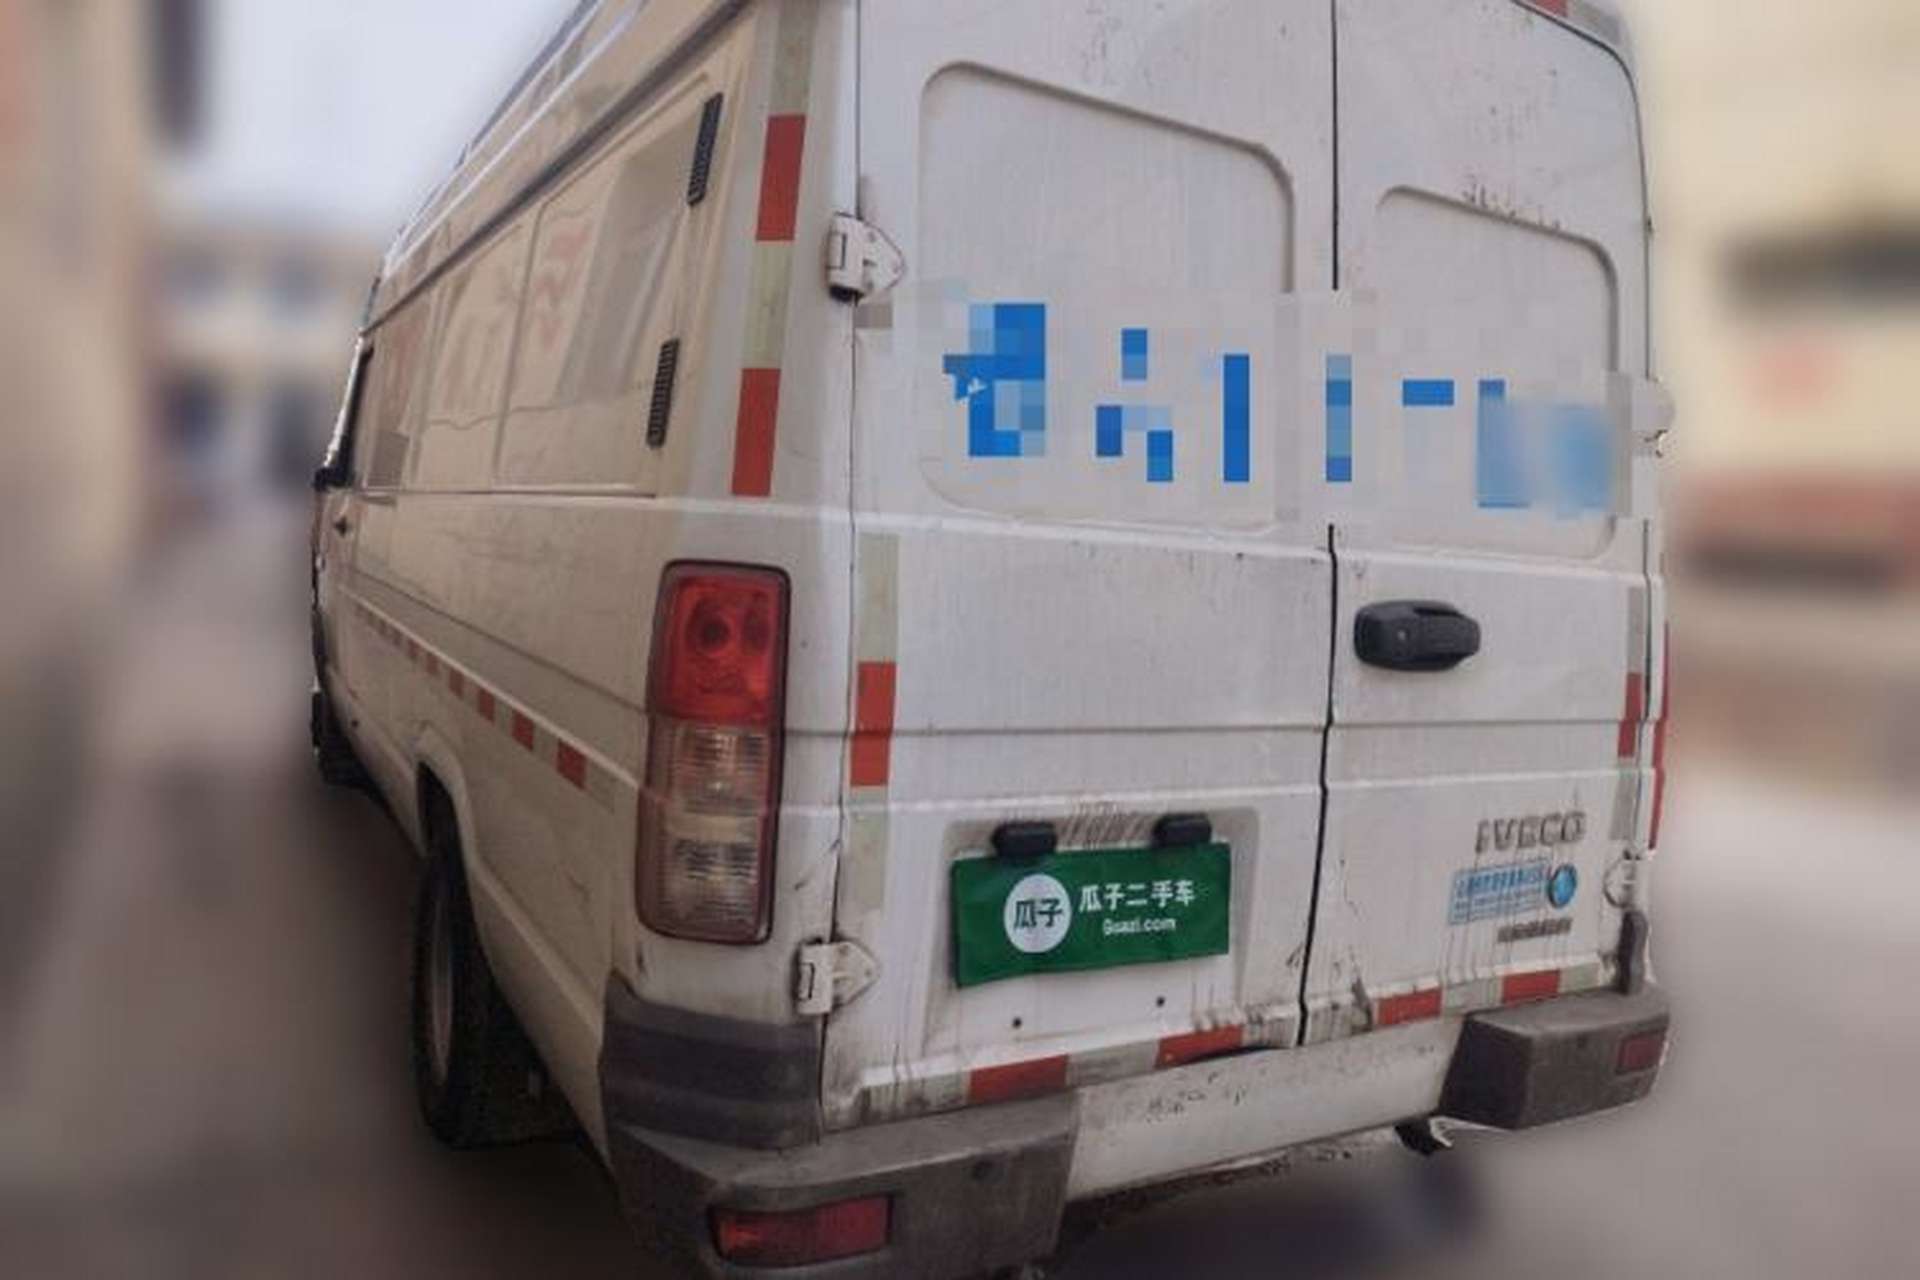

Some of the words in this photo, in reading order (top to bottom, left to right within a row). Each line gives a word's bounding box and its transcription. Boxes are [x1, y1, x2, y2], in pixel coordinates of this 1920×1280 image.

[1475, 810, 1586, 853] IVECO
[1079, 880, 1196, 912] 瓜子二手车
[1014, 898, 1063, 929] 瓜子
[1103, 916, 1176, 937] Guazi.com
